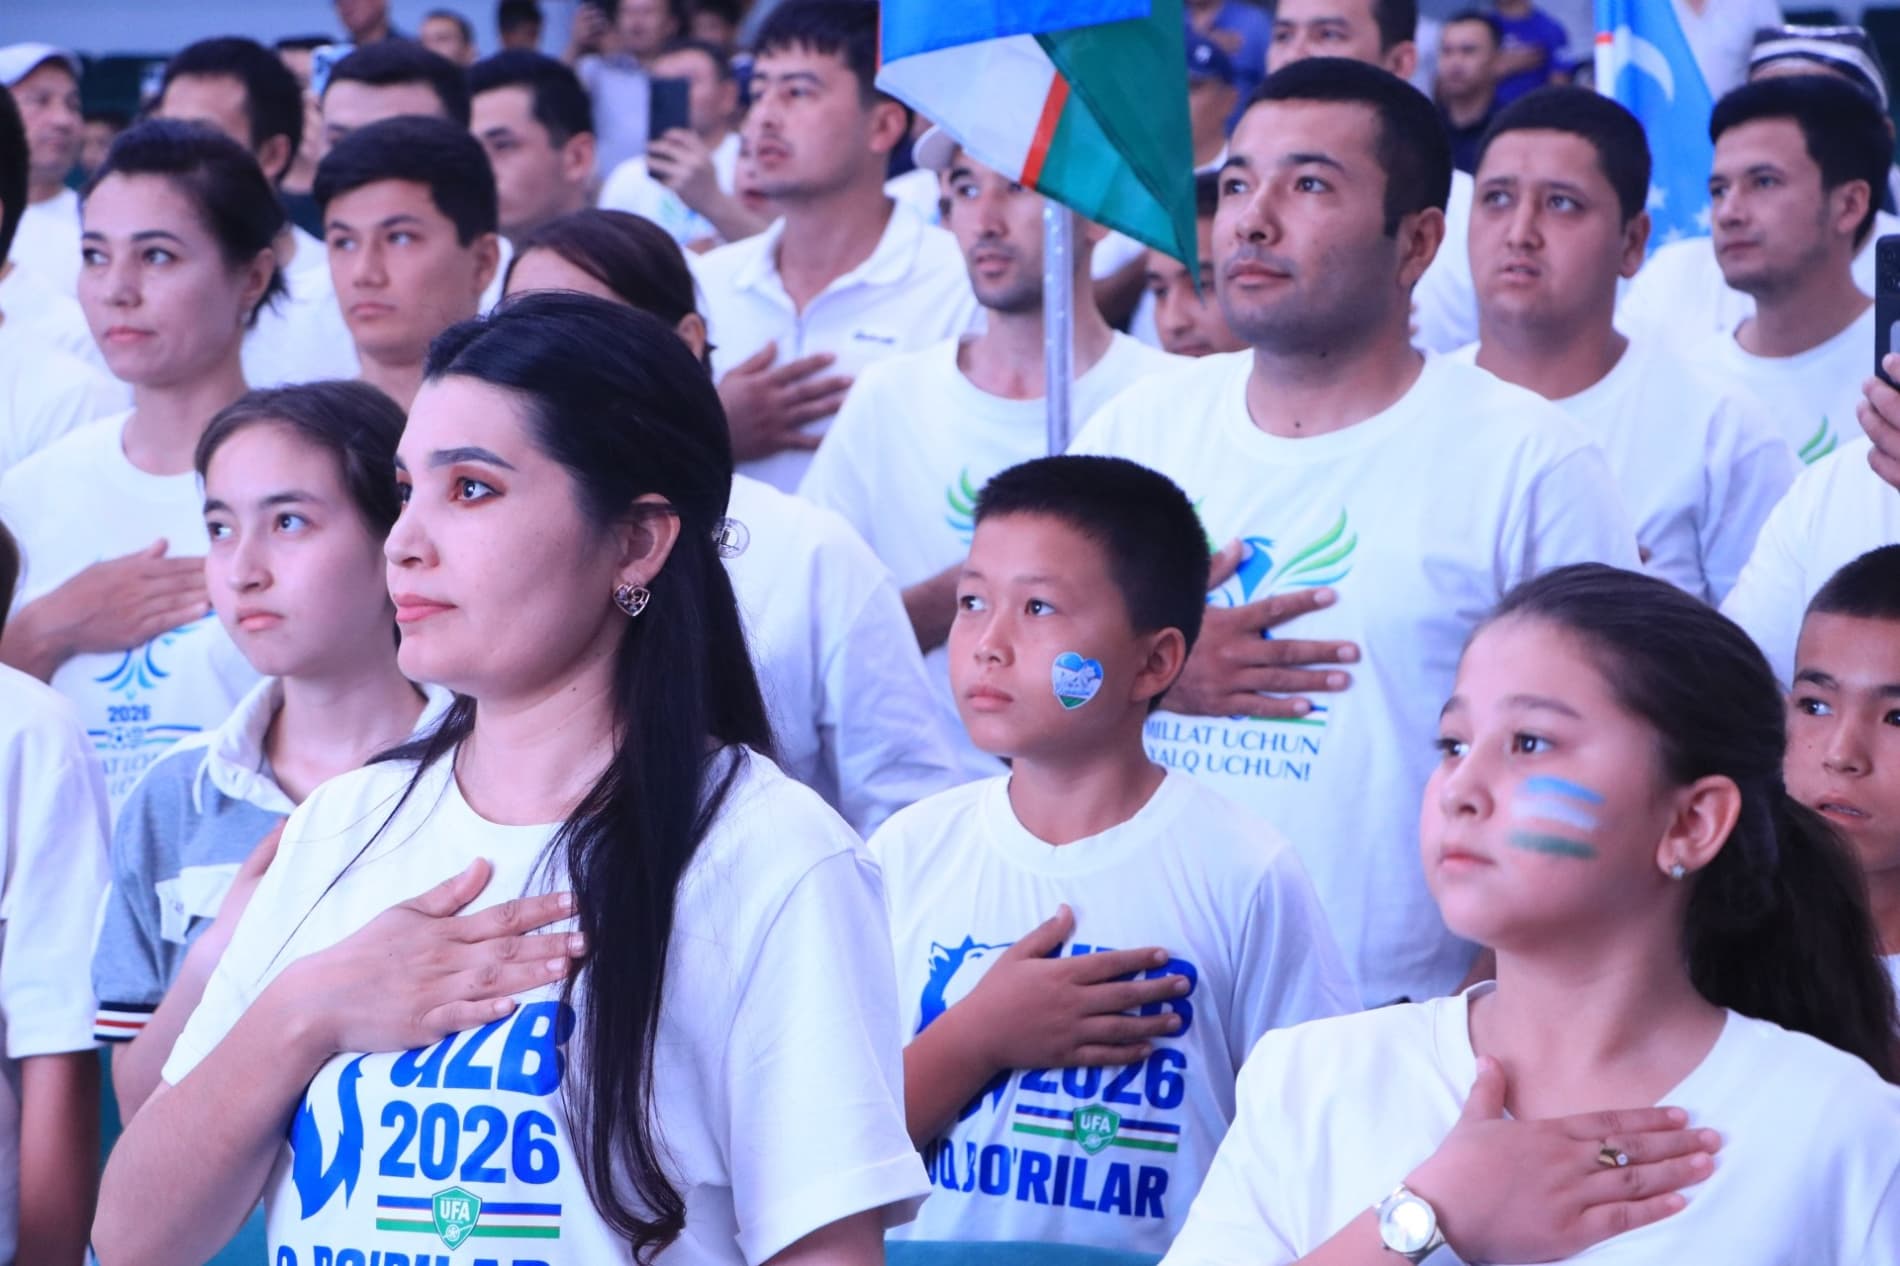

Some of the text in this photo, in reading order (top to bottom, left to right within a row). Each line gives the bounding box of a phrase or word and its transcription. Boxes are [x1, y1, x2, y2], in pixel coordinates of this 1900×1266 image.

[107, 705, 151, 721] 2026
[1223, 728, 1321, 756] UCHUN
[1207, 754, 1311, 782] UCHUN!
[1080, 1115, 1111, 1132] UFA
[379, 1101, 560, 1185] 2026
[440, 1199, 471, 1222] UFA
